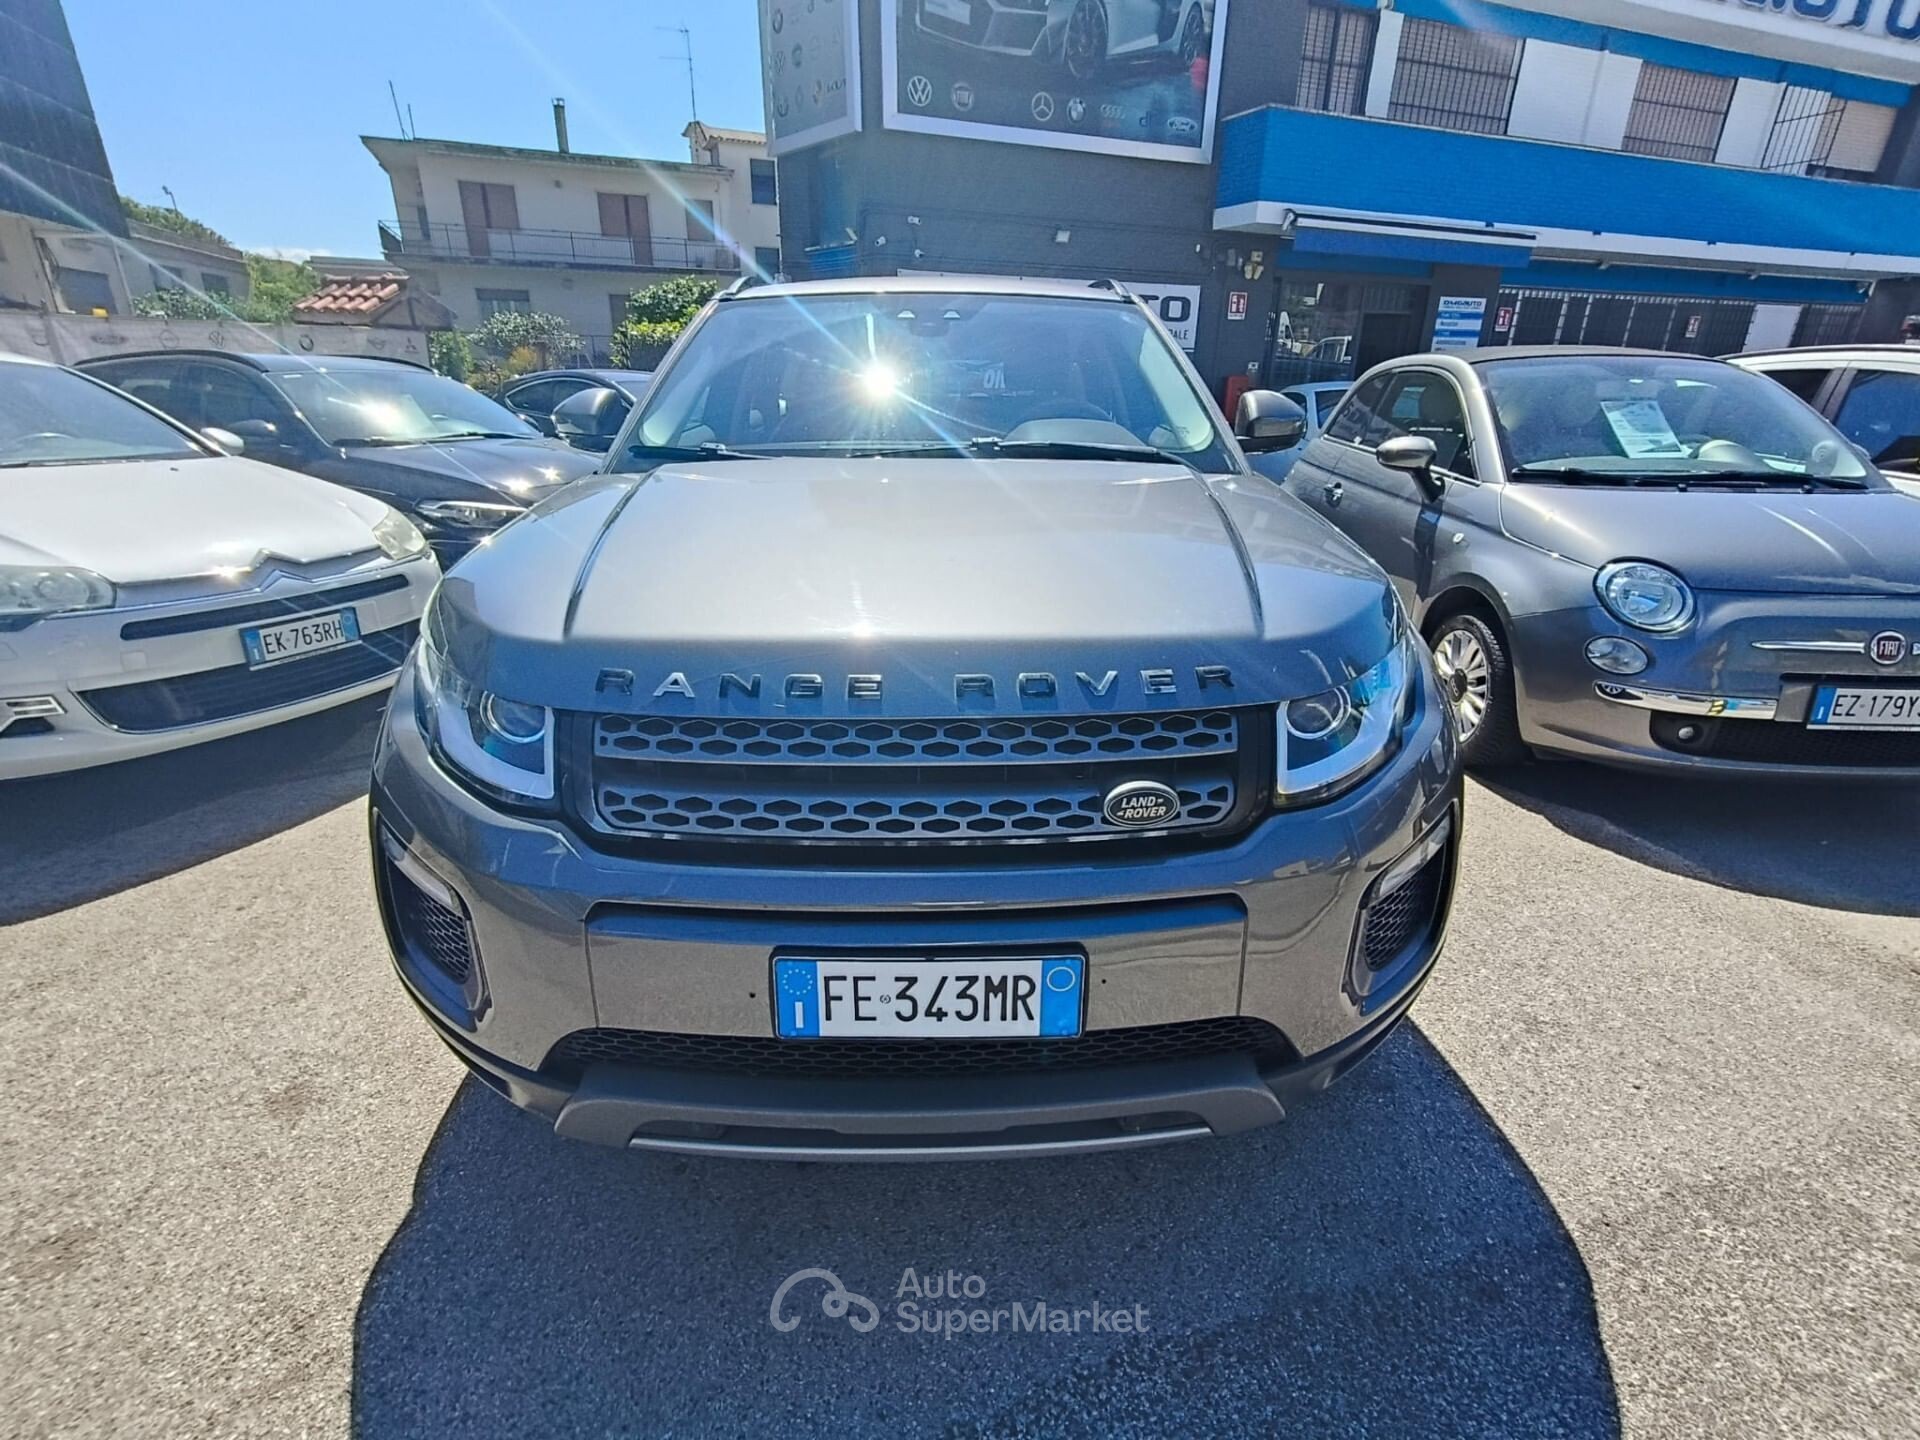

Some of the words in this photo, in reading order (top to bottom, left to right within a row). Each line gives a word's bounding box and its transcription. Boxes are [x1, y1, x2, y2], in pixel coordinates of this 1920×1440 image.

[263, 631, 287, 654] EK
[290, 620, 344, 649] 763RH
[1879, 640, 1900, 656] FIAT
[595, 667, 883, 699] RANGE
[954, 665, 1235, 699] ROVER
[1832, 694, 1862, 717] EZ
[1868, 695, 1920, 718] 179Y
[823, 975, 877, 1022] FE
[894, 974, 1037, 1022] 343MR
